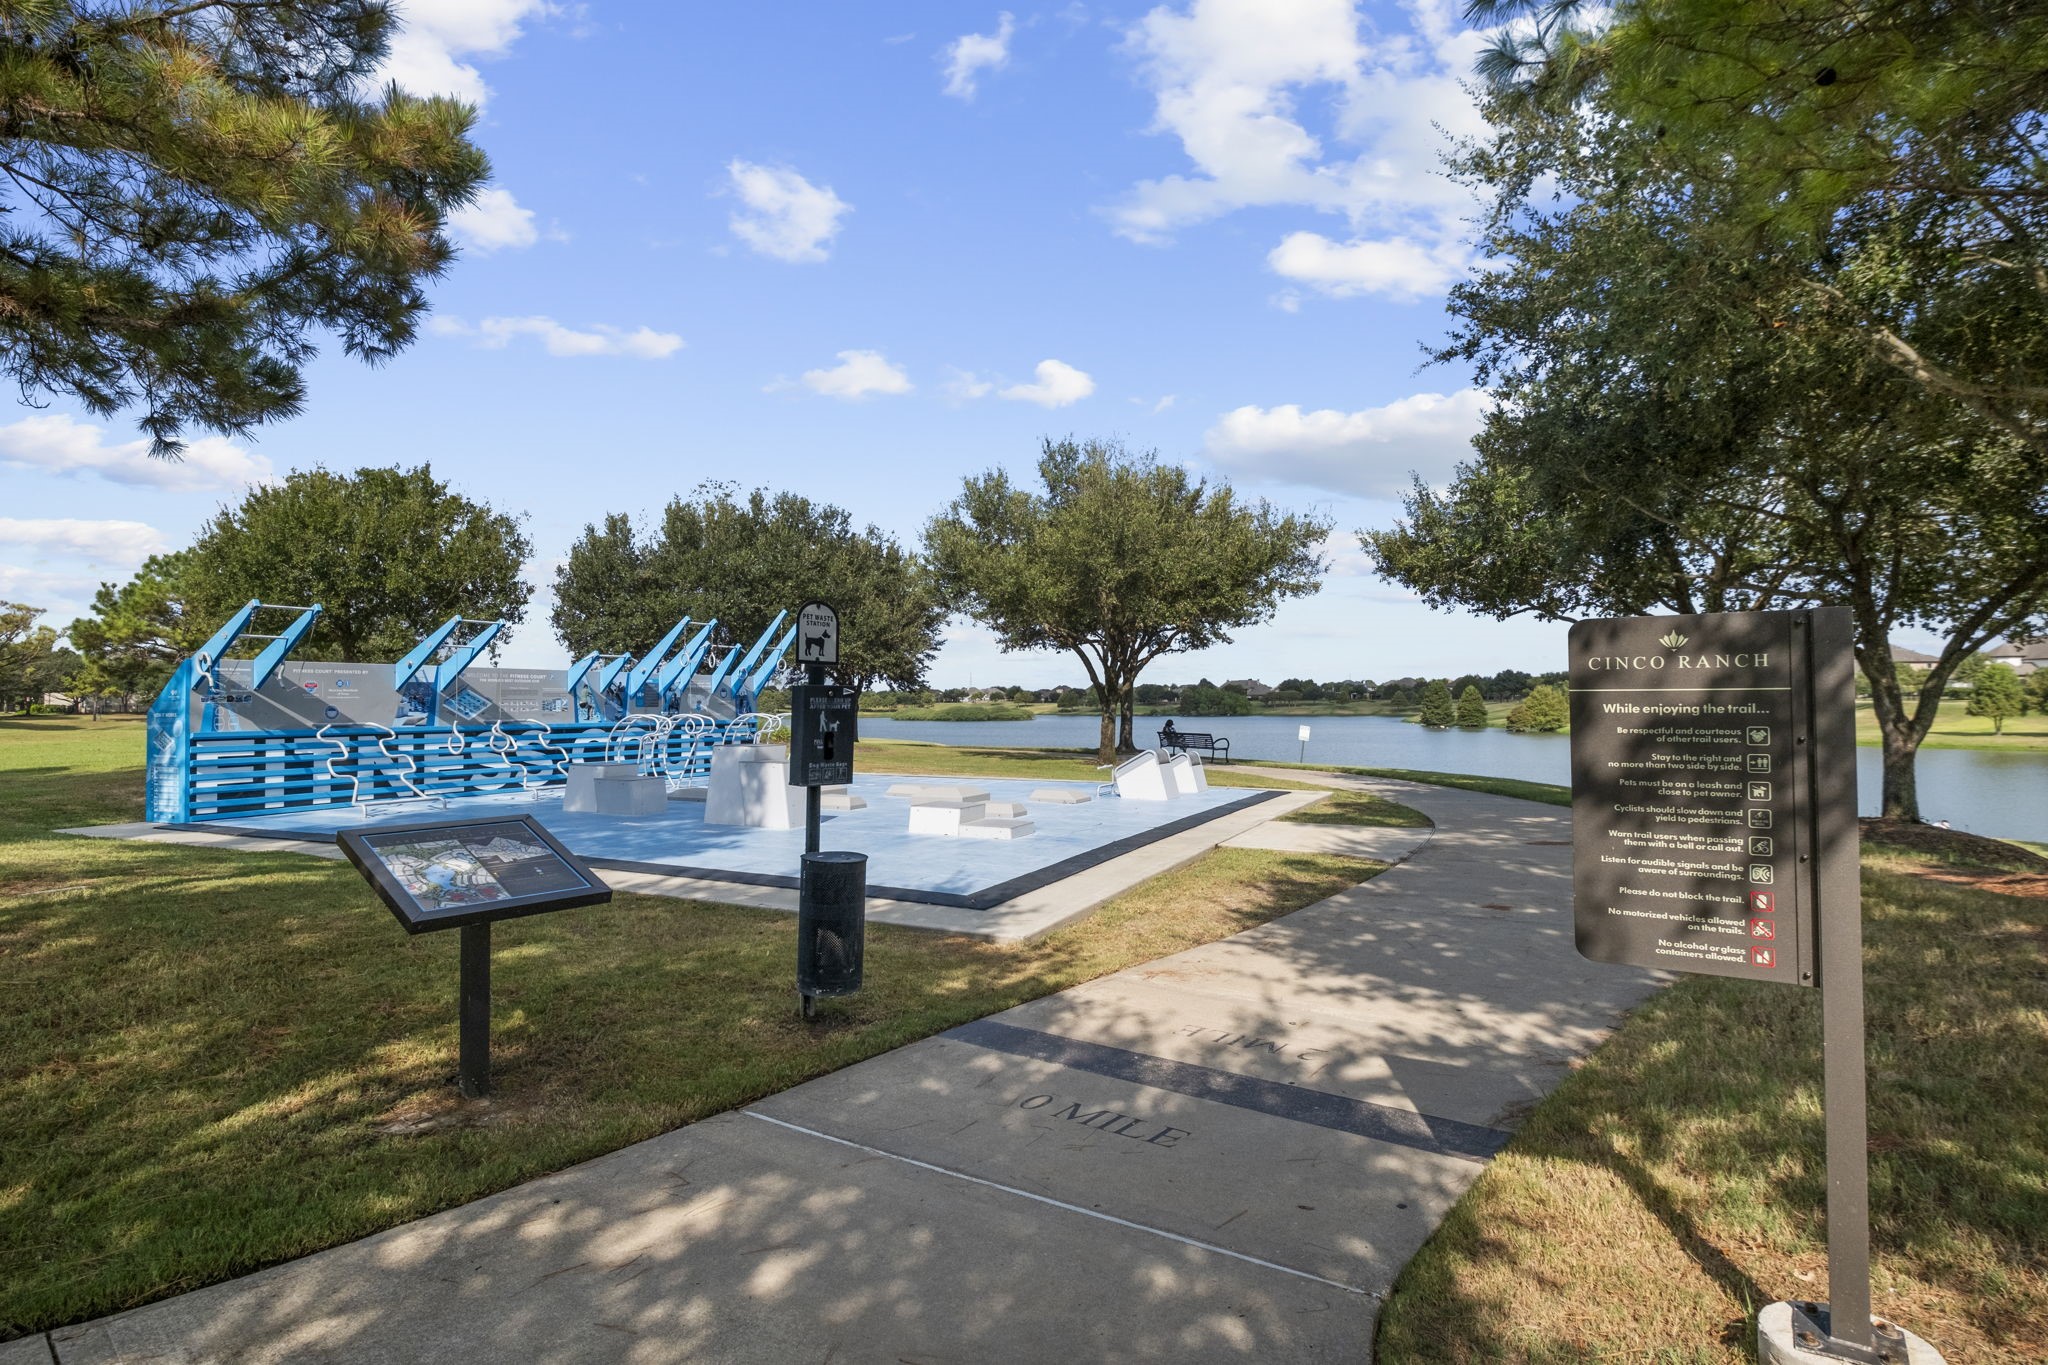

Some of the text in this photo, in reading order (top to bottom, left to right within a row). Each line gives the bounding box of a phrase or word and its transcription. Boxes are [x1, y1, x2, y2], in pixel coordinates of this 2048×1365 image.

[1588, 653, 1769, 671] CINCO RANCH
[1603, 703, 1770, 716] While enjoying the trail...
[1630, 727, 1673, 736] respectful
[1652, 753, 1671, 762] Stay
[1700, 755, 1721, 763] right
[1646, 761, 1666, 769] than
[1687, 762, 1705, 770] side
[1707, 763, 1718, 772] by
[1620, 778, 1637, 786] Pets
[1662, 779, 1673, 787] be
[1697, 781, 1721, 789] leash
[1724, 782, 1742, 790] and
[1694, 790, 1709, 798] pet
[1614, 804, 1743, 817] Cyclists should slow down and
[1655, 814, 1676, 823] yield
[1688, 816, 1743, 825] pedestrians.
[1608, 830, 1743, 846] Warn trail users when passing
[1624, 839, 1646, 847] them
[1648, 840, 1667, 848] with
[1677, 842, 1694, 850] bell
[1707, 843, 1723, 851] call
[1725, 845, 1744, 853] out.
[1601, 855, 1744, 872] Listen for audible signals and be
[1679, 869, 1744, 881] surroundings.
[1619, 887, 1647, 896] Please
[1649, 889, 1660, 897] do
[1679, 892, 1704, 900] block
[1705, 894, 1720, 902] the
[1722, 896, 1745, 904] trail.
[1608, 907, 1745, 927] No motorized vehicles allowed
[1702, 924, 1717, 932] the
[1718, 926, 1745, 935] trails.
[1659, 939, 1671, 947] No
[1674, 941, 1708, 951] alcohol
[1721, 947, 1746, 955] glass
[1655, 948, 1746, 963] containers allowed.
[1181, 1024, 1289, 1054] MILE
[1050, 1102, 1192, 1148] MILE
